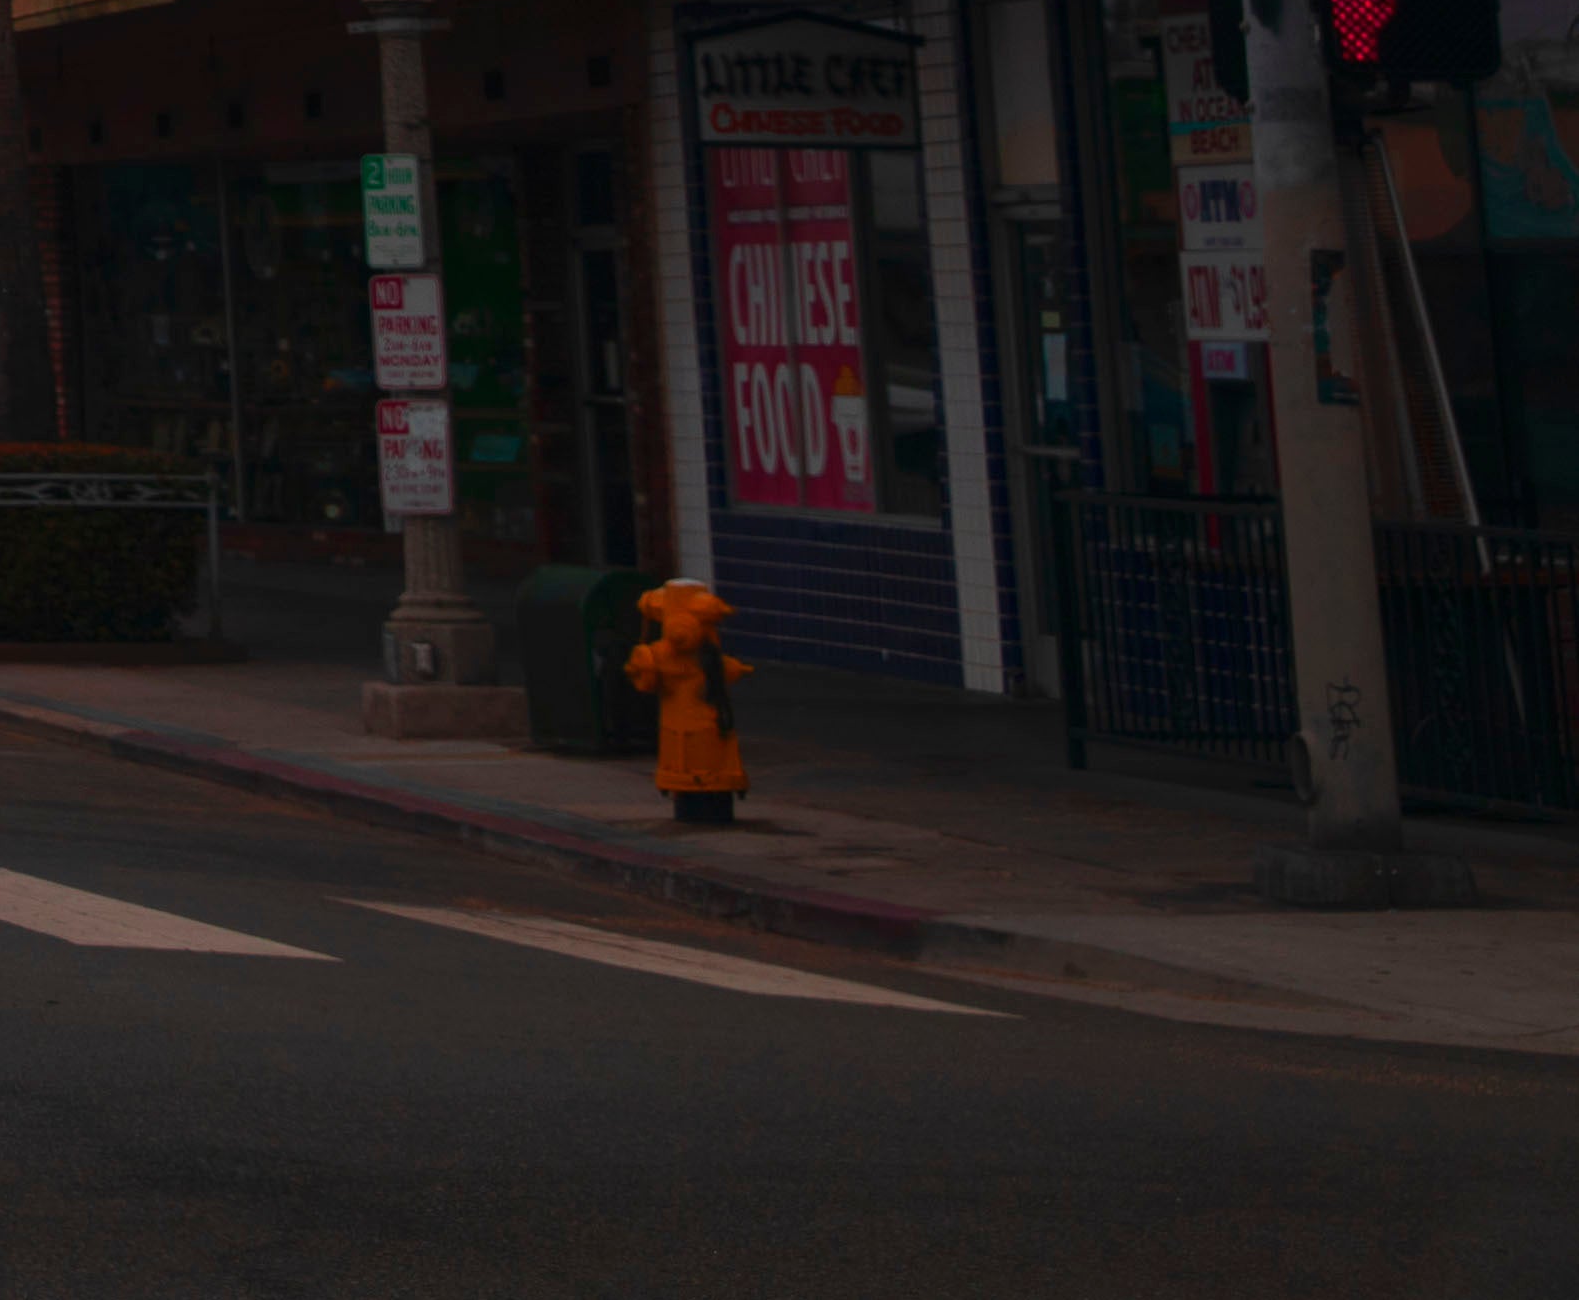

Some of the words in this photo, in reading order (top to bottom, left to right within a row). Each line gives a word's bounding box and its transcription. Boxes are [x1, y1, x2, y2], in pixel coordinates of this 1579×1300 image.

[701, 53, 813, 98] LITTLE
[824, 54, 908, 98] CHEF
[710, 102, 827, 135] CHINESE
[830, 105, 904, 136] FOOD
[368, 161, 381, 185] 2
[375, 279, 400, 304] NO
[727, 240, 860, 348] CHINESE
[378, 315, 438, 337] PARKING
[379, 354, 441, 368] MONDAY
[732, 361, 830, 479] FOOD
